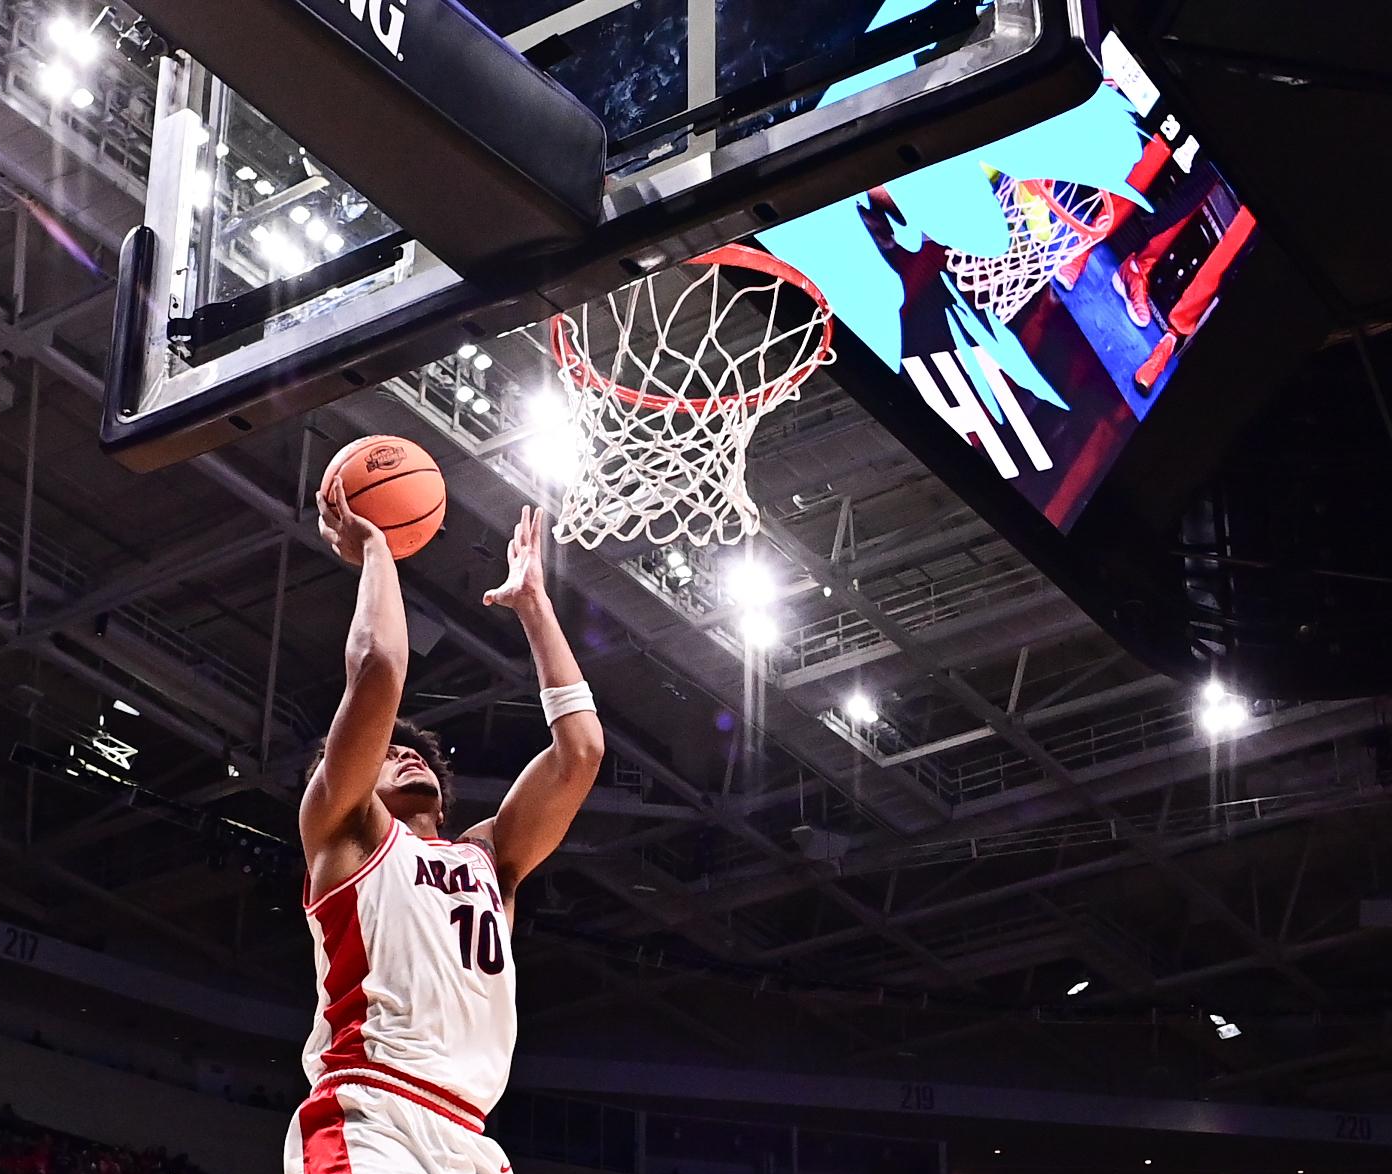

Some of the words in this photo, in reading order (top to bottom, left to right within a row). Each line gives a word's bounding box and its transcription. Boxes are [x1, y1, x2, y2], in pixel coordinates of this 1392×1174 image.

[3, 927, 39, 961] 217
[450, 905, 505, 975] 10
[901, 1084, 935, 1110] 219
[1336, 1114, 1371, 1140] 220
